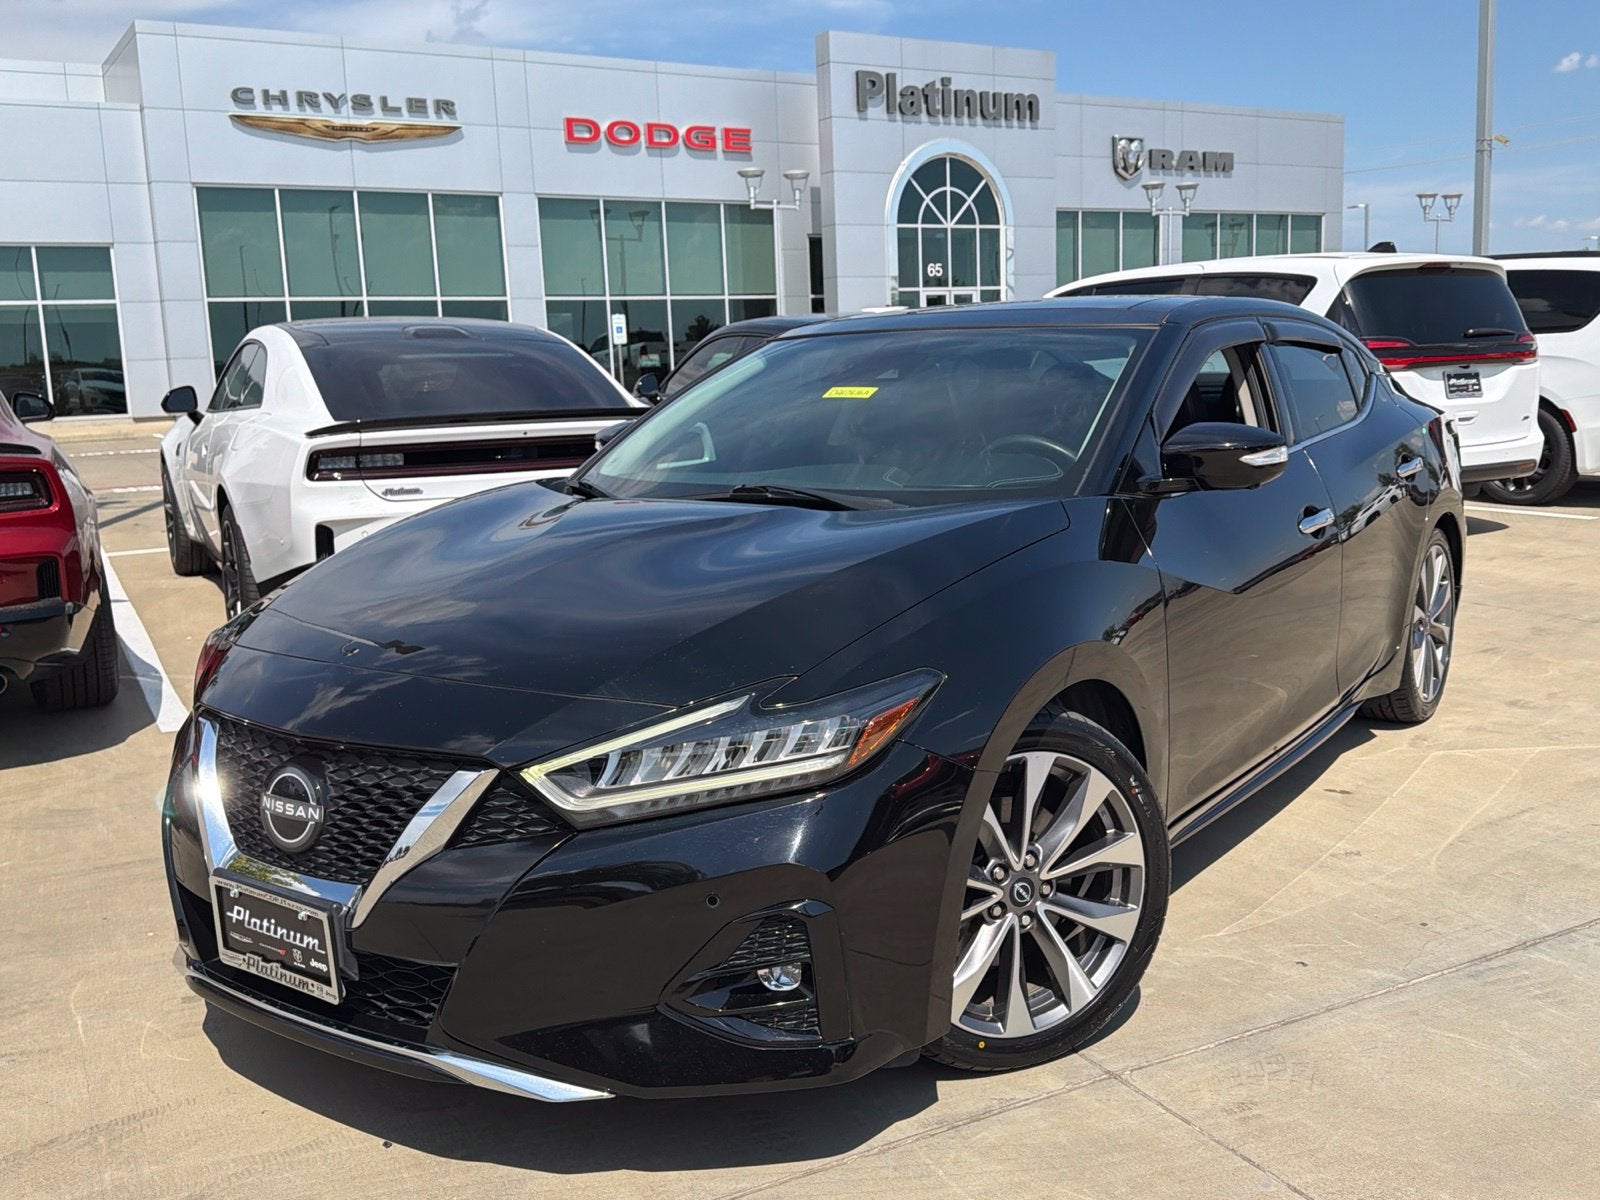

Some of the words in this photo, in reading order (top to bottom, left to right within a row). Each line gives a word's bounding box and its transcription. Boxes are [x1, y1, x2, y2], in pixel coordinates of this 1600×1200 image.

[230, 87, 457, 116] CHRYSLER
[856, 70, 1040, 122] Platinum
[563, 117, 752, 152] DODGE
[1148, 149, 1234, 172] RAM
[927, 263, 943, 277] 65
[262, 795, 319, 820] NISSAN
[226, 905, 326, 955] Platinum
[246, 956, 315, 994] Platinum
[309, 958, 328, 973] Jeep
